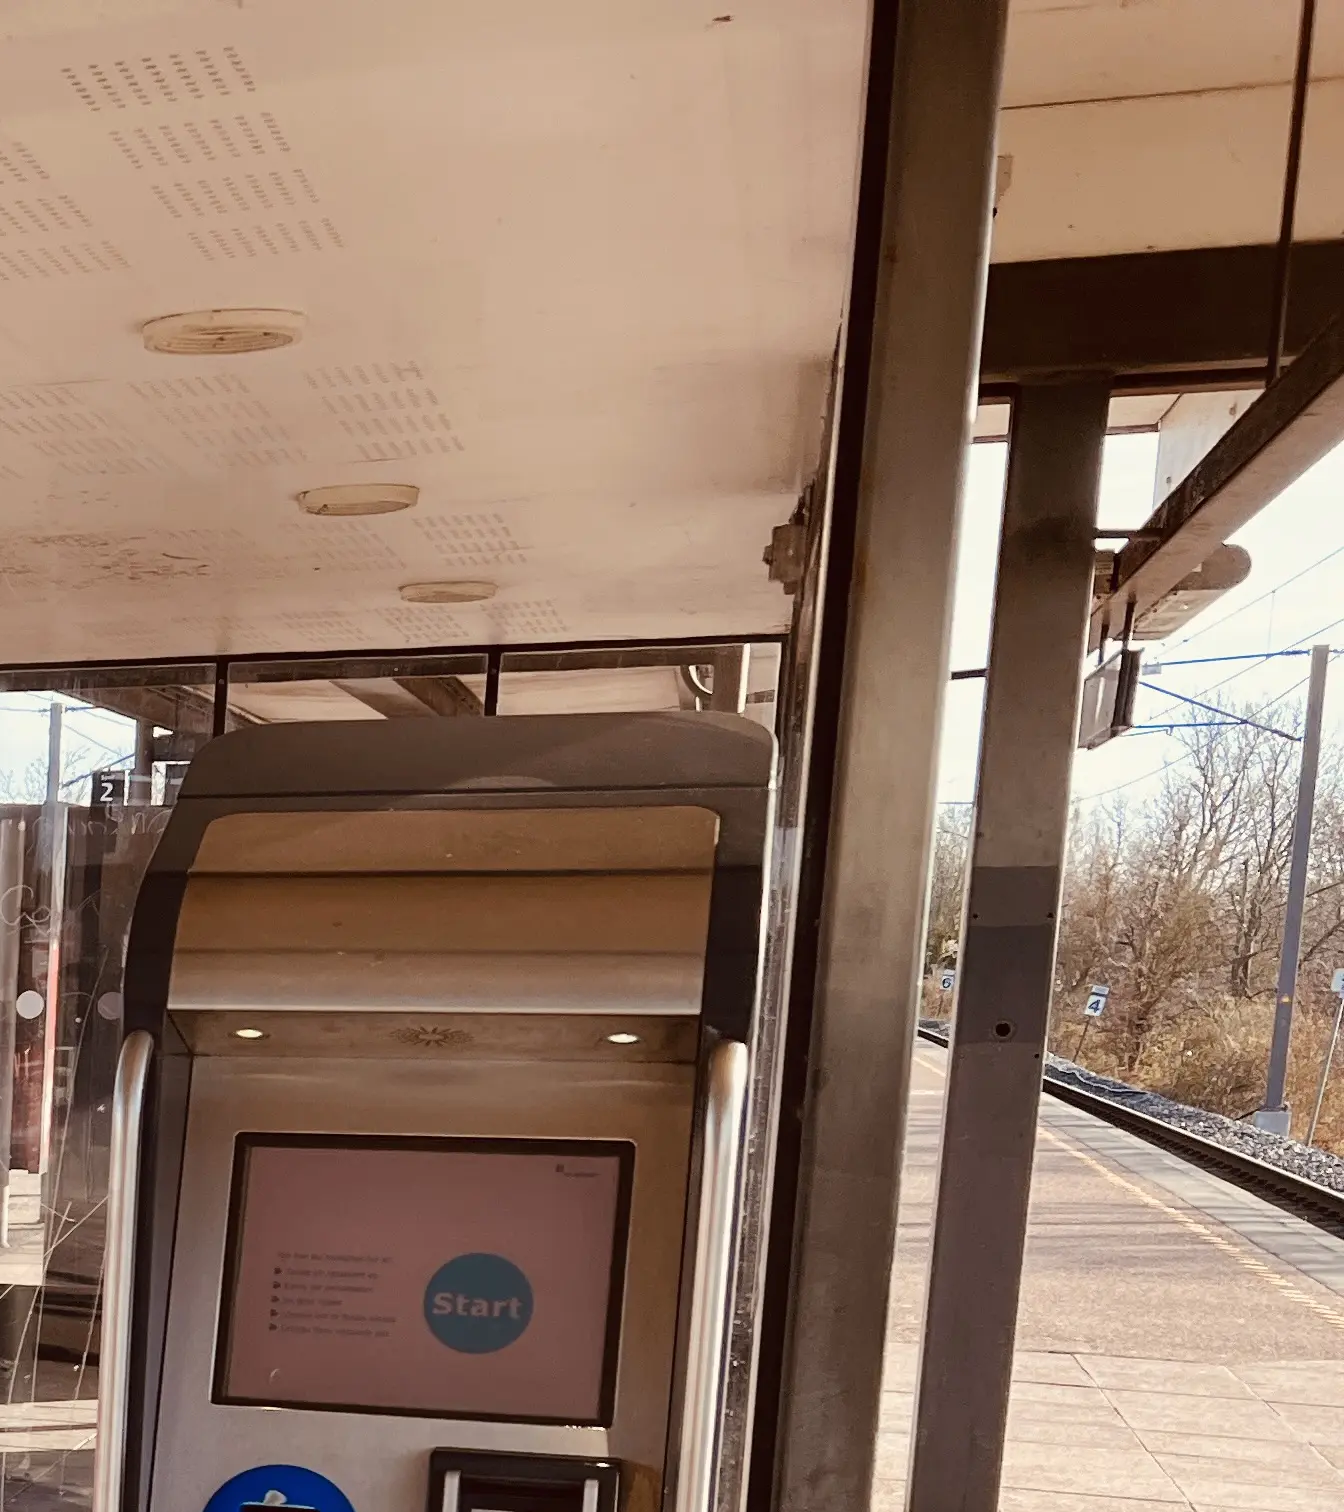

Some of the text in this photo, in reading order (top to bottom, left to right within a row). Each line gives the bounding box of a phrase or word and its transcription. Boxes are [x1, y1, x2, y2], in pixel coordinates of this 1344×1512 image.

[100, 782, 113, 801] 2
[942, 978, 951, 988] 6
[1088, 1000, 1100, 1013] 4
[433, 1292, 523, 1319] Start
